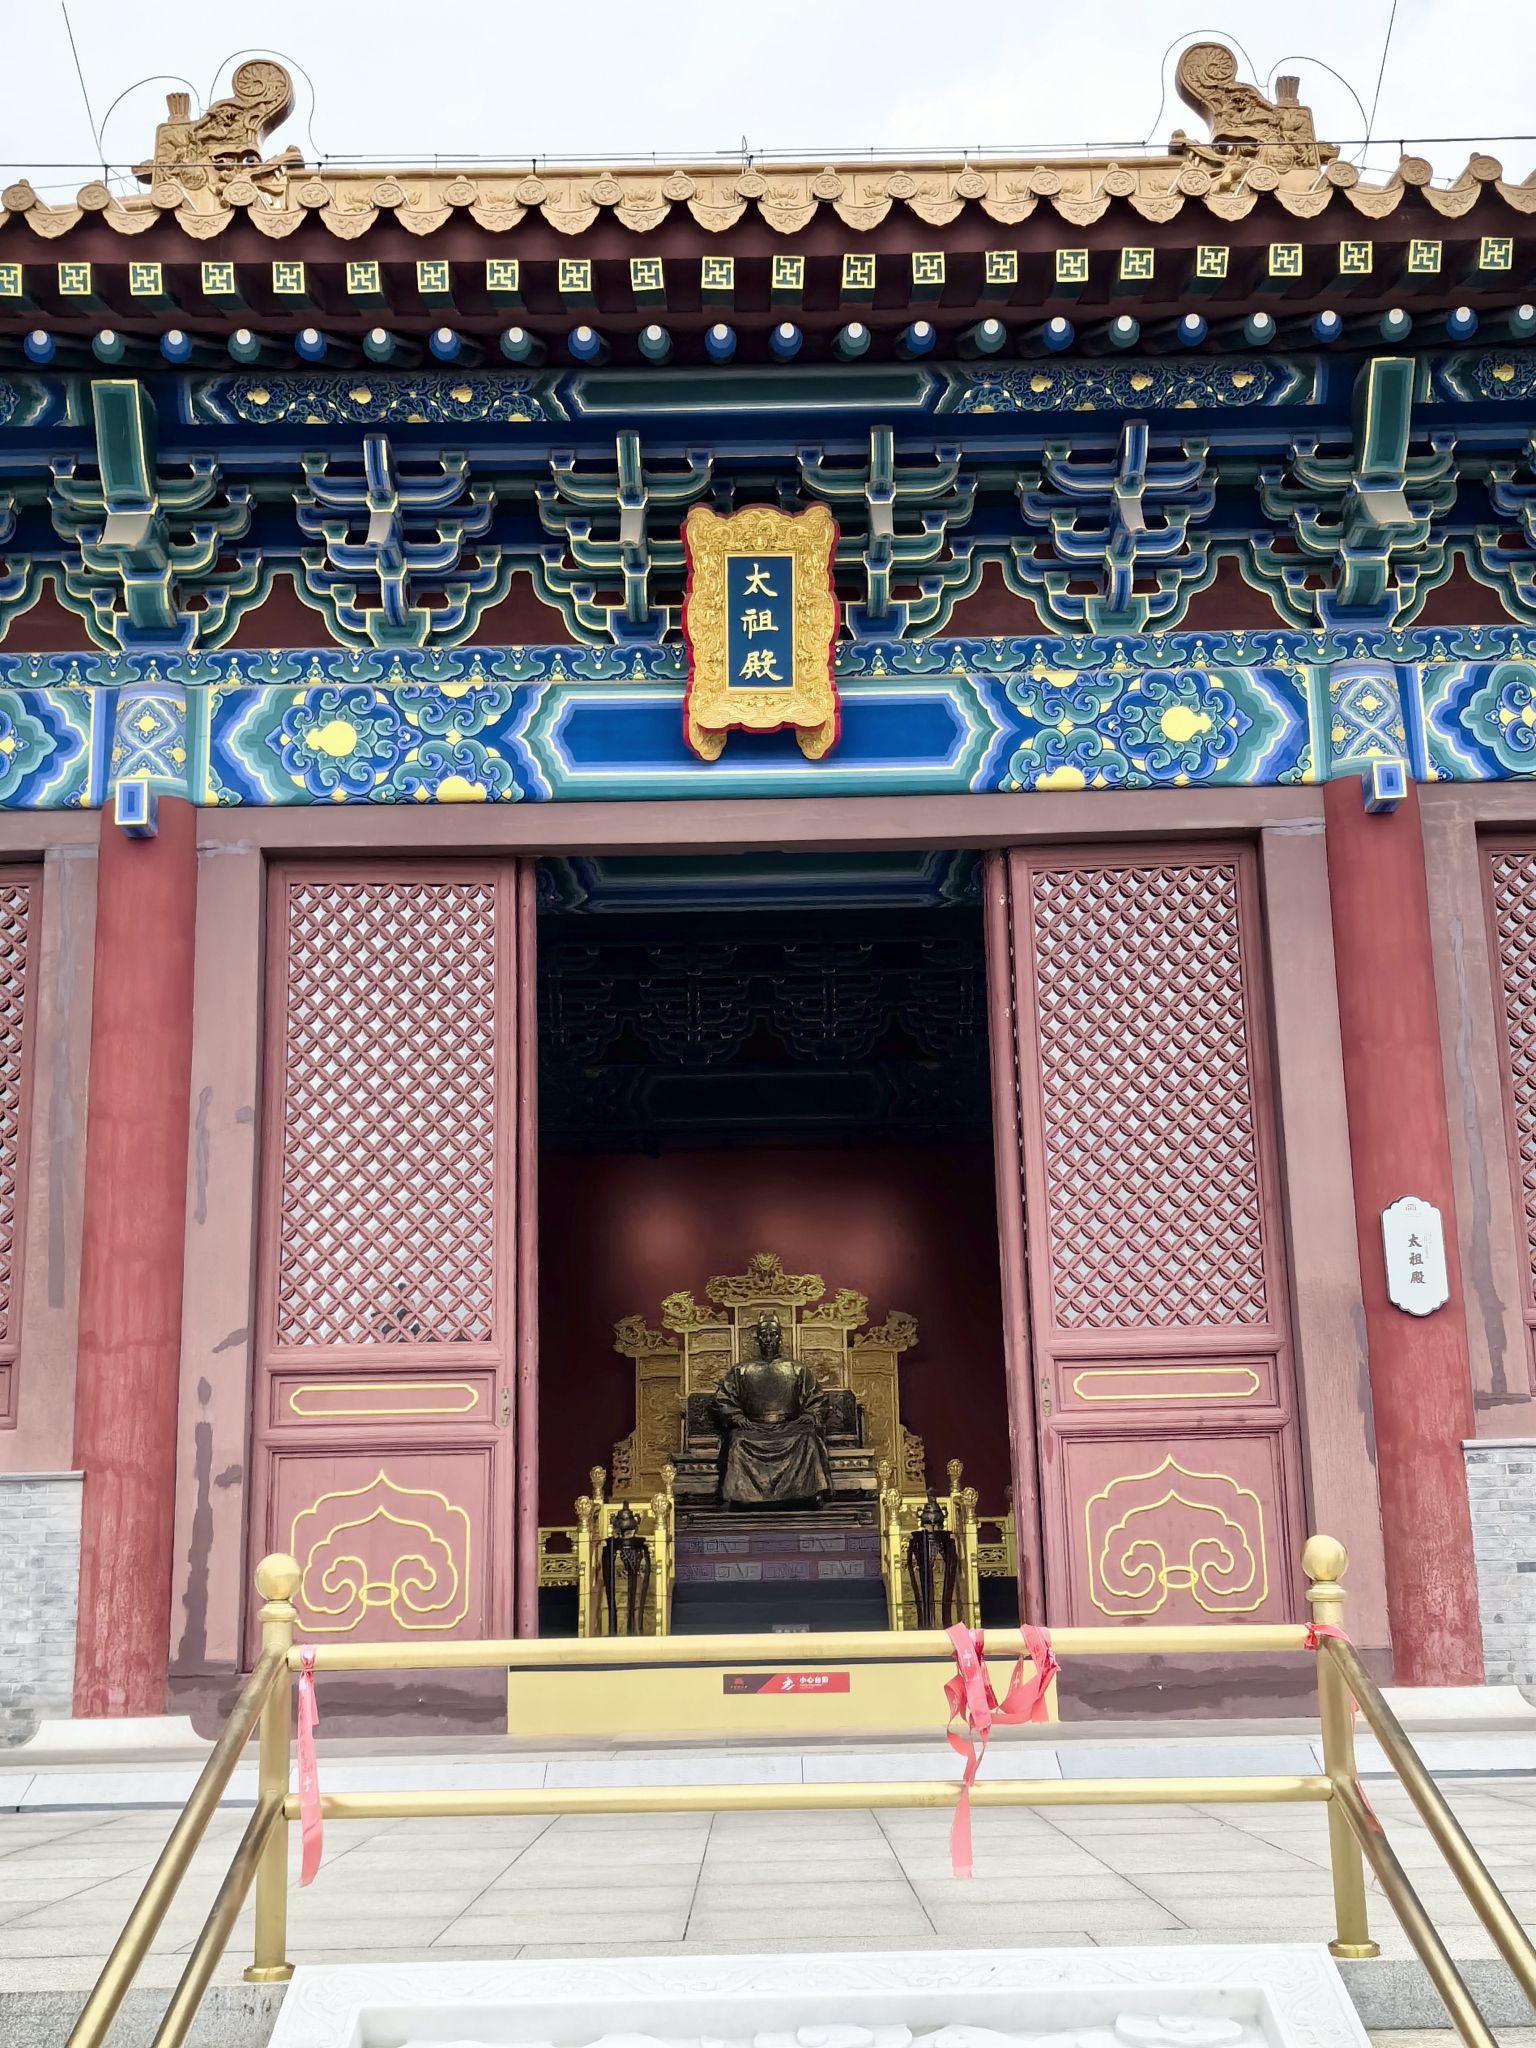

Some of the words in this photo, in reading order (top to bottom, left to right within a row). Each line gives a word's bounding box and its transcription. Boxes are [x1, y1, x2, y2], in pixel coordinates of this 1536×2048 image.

[738, 563, 783, 681] 太祖殿
[1408, 1233, 1426, 1284] 太祖殿
